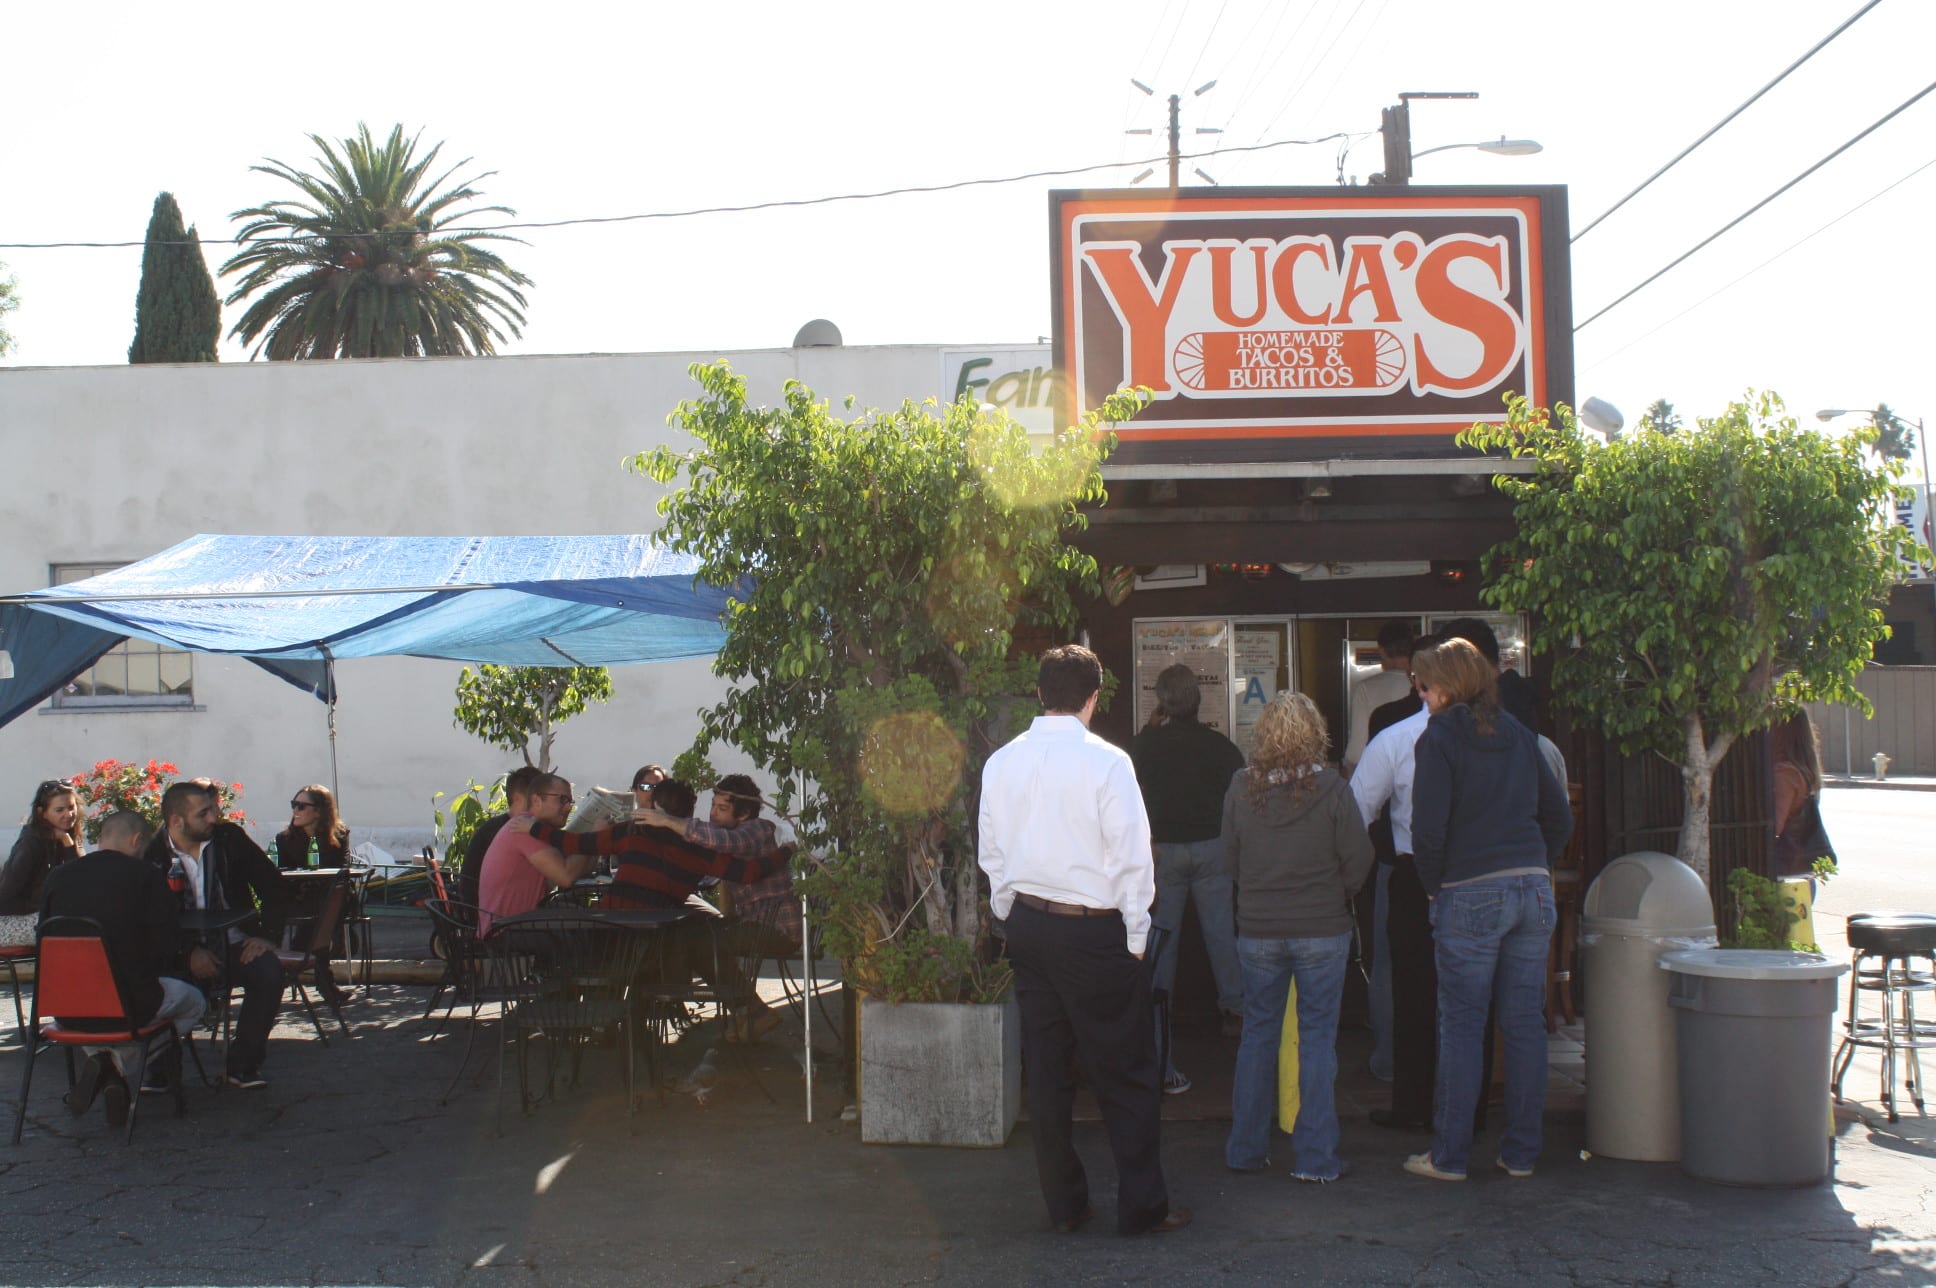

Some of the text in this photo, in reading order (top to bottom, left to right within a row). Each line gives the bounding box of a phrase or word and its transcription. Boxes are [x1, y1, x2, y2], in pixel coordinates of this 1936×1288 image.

[1083, 240, 1518, 392] YUCA'S
[1238, 332, 1344, 348] HOMEMADE
[1236, 347, 1344, 368] TACOS &
[1229, 366, 1354, 389] BURRITOS
[1243, 676, 1267, 705] A
